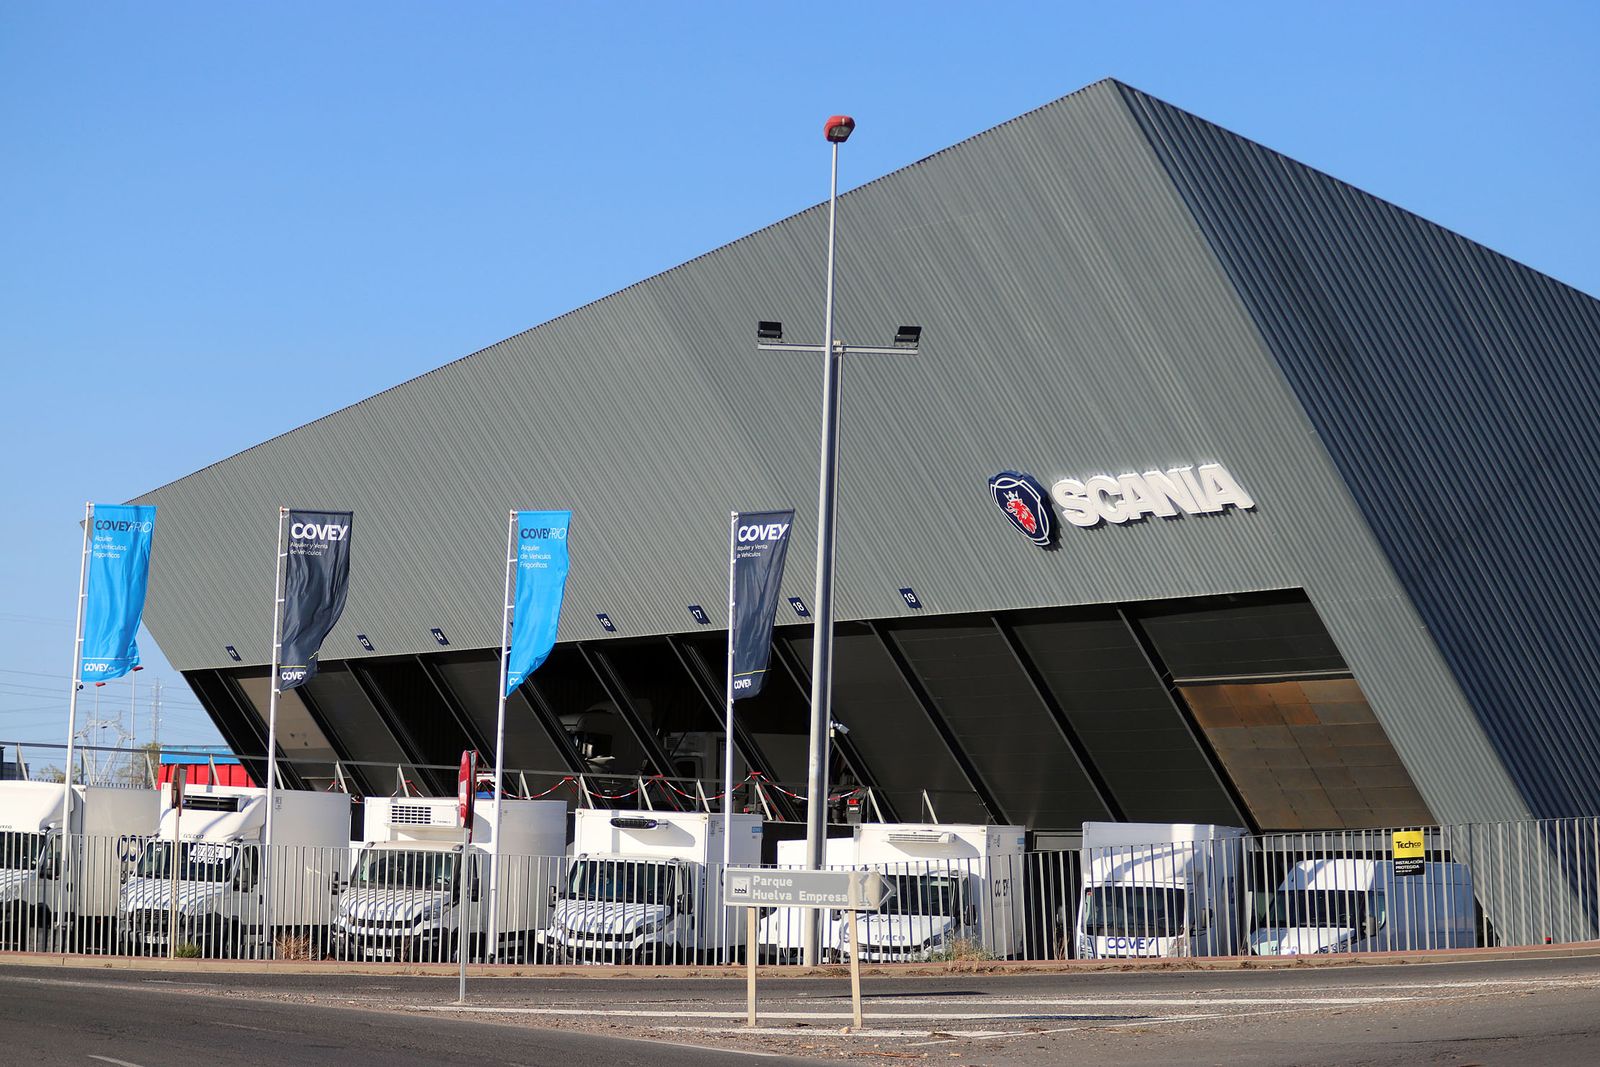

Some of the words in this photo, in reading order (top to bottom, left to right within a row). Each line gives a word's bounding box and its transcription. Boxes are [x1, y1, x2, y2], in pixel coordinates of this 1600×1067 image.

[1051, 463, 1256, 527] SCANIA
[291, 523, 348, 541] COVEY
[738, 523, 790, 542] COVEY
[904, 592, 916, 603] 19
[793, 602, 804, 611] 18
[692, 609, 702, 619] 17
[600, 617, 611, 627] 16
[753, 875, 793, 888] Parque
[752, 889, 792, 900] Huelva
[1107, 937, 1155, 950] COVEY
